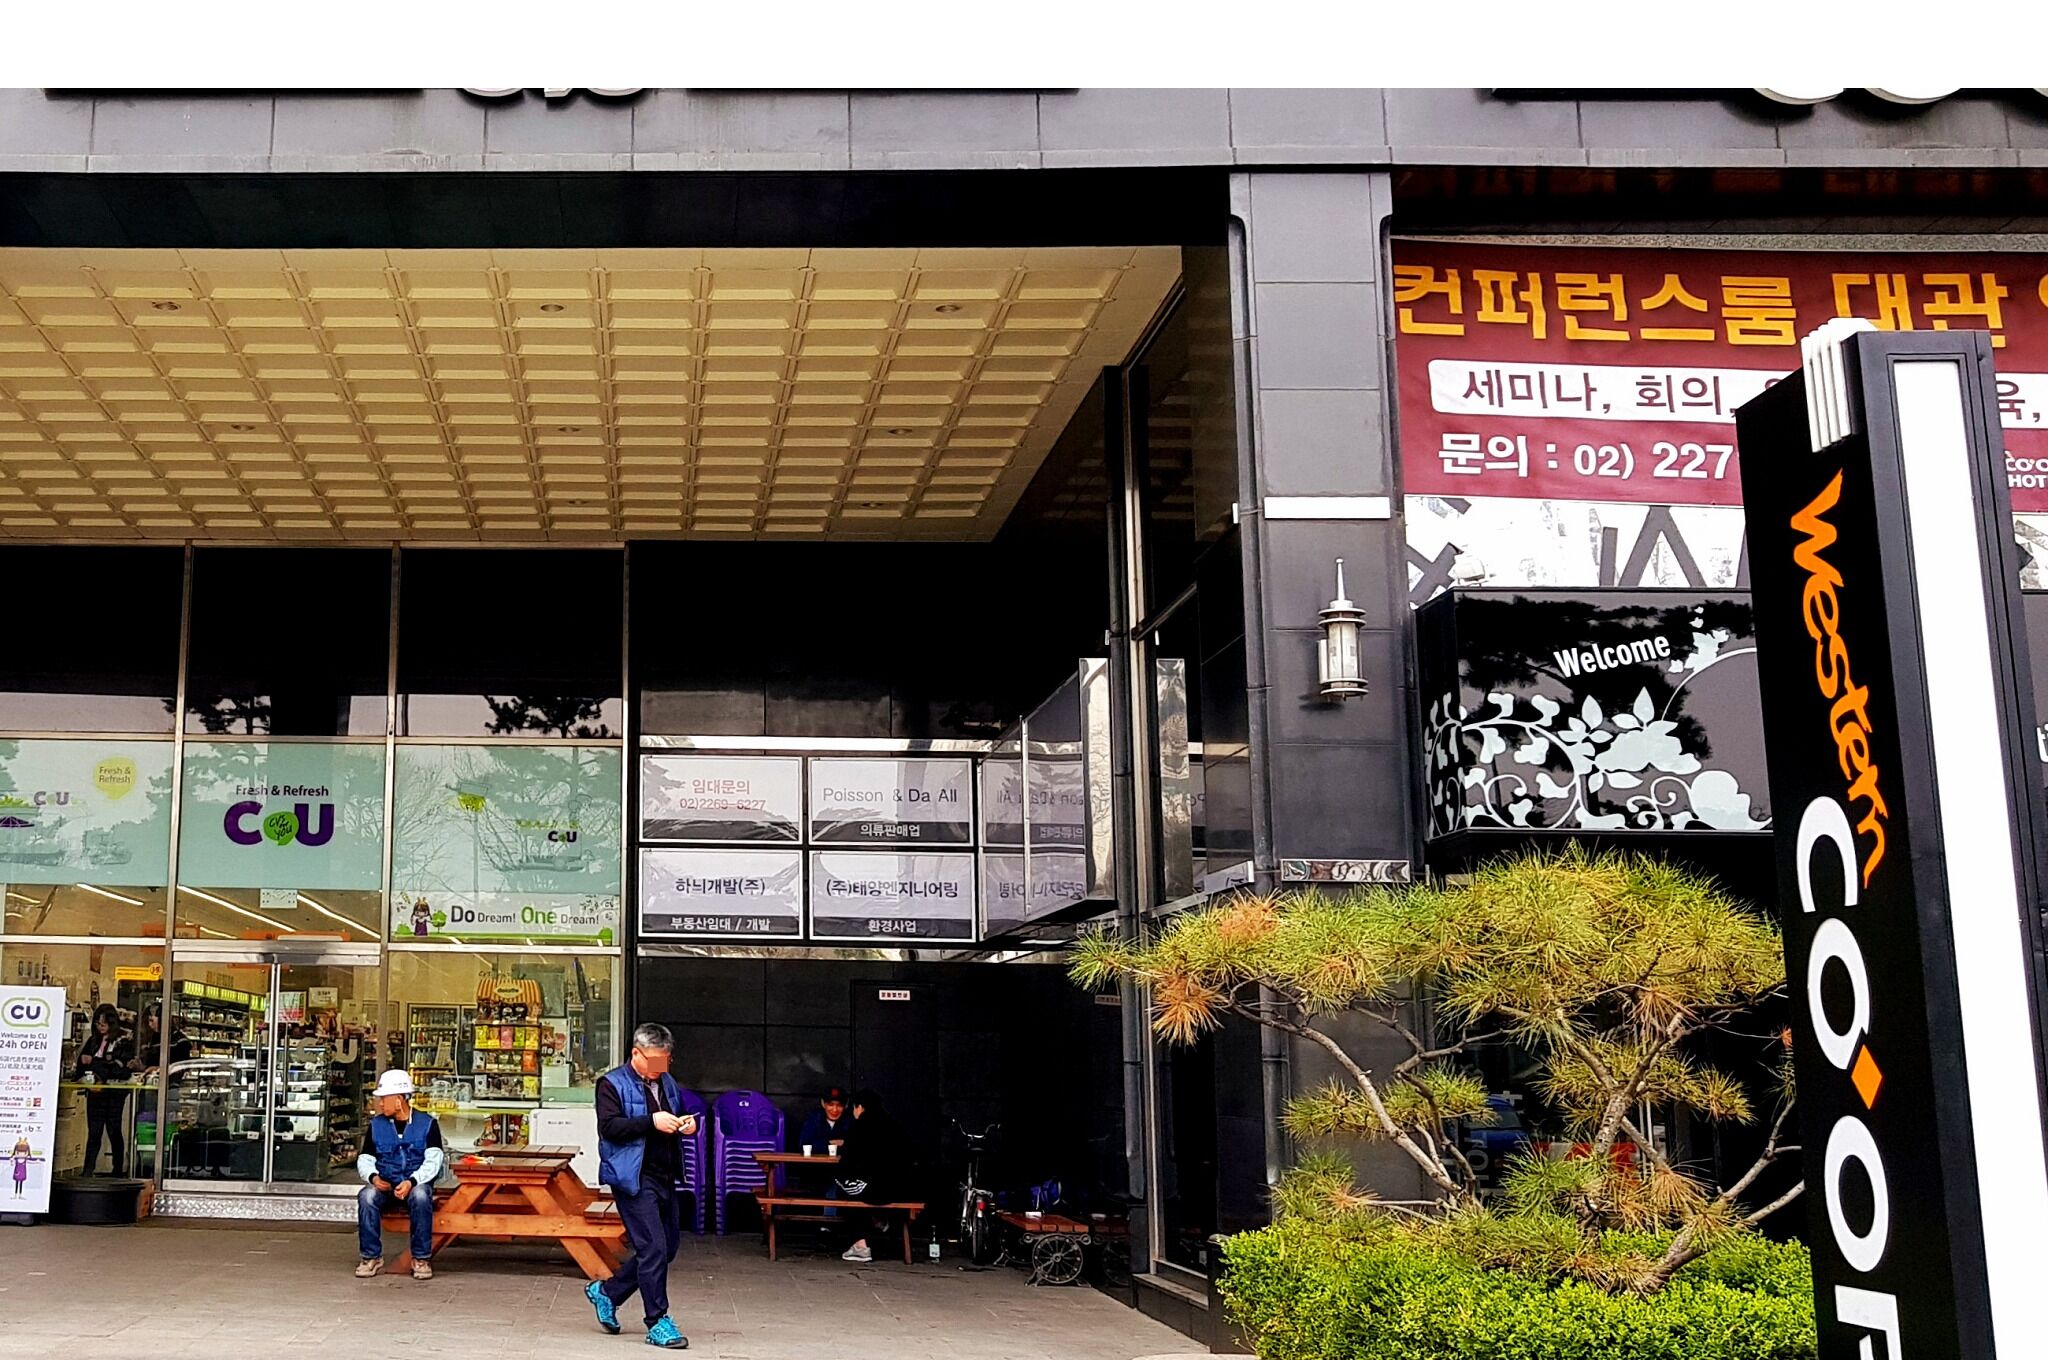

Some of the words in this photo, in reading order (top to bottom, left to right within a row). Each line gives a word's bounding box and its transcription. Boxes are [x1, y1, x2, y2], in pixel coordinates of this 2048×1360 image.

[1393, 264, 1797, 346] 컨퍼런스룸
[1832, 272, 2008, 348] 대관
[1462, 369, 1612, 414] 세미나,
[1438, 433, 1528, 478] 문의
[1573, 443, 1634, 480] 02)
[1553, 636, 1671, 678] Welcome
[1790, 467, 1889, 890] Western
[99, 766, 123, 775] Fresh
[98, 774, 131, 784] Refresh
[692, 779, 750, 795] 임대문의
[235, 785, 268, 796] Fresh
[271, 785, 281, 796] &
[283, 785, 329, 796] Refresh
[823, 787, 884, 801] Poisson
[893, 788, 903, 802] &
[908, 788, 931, 802] Da
[938, 788, 958, 803] All
[548, 830, 578, 843] CU
[860, 824, 921, 838] 의류판매업
[675, 878, 766, 896] 하늬개발(주)
[826, 879, 958, 898] (주)태양엔지니어링
[451, 905, 475, 923] Do
[477, 912, 516, 924] Dream!
[521, 905, 557, 924] One
[560, 912, 600, 925] Dream!
[671, 916, 731, 931] 부동산임대
[747, 918, 770, 932] 개발
[868, 919, 917, 933] 환경사업
[10, 1004, 41, 1020] CU
[20, 1040, 48, 1050] OPEN
